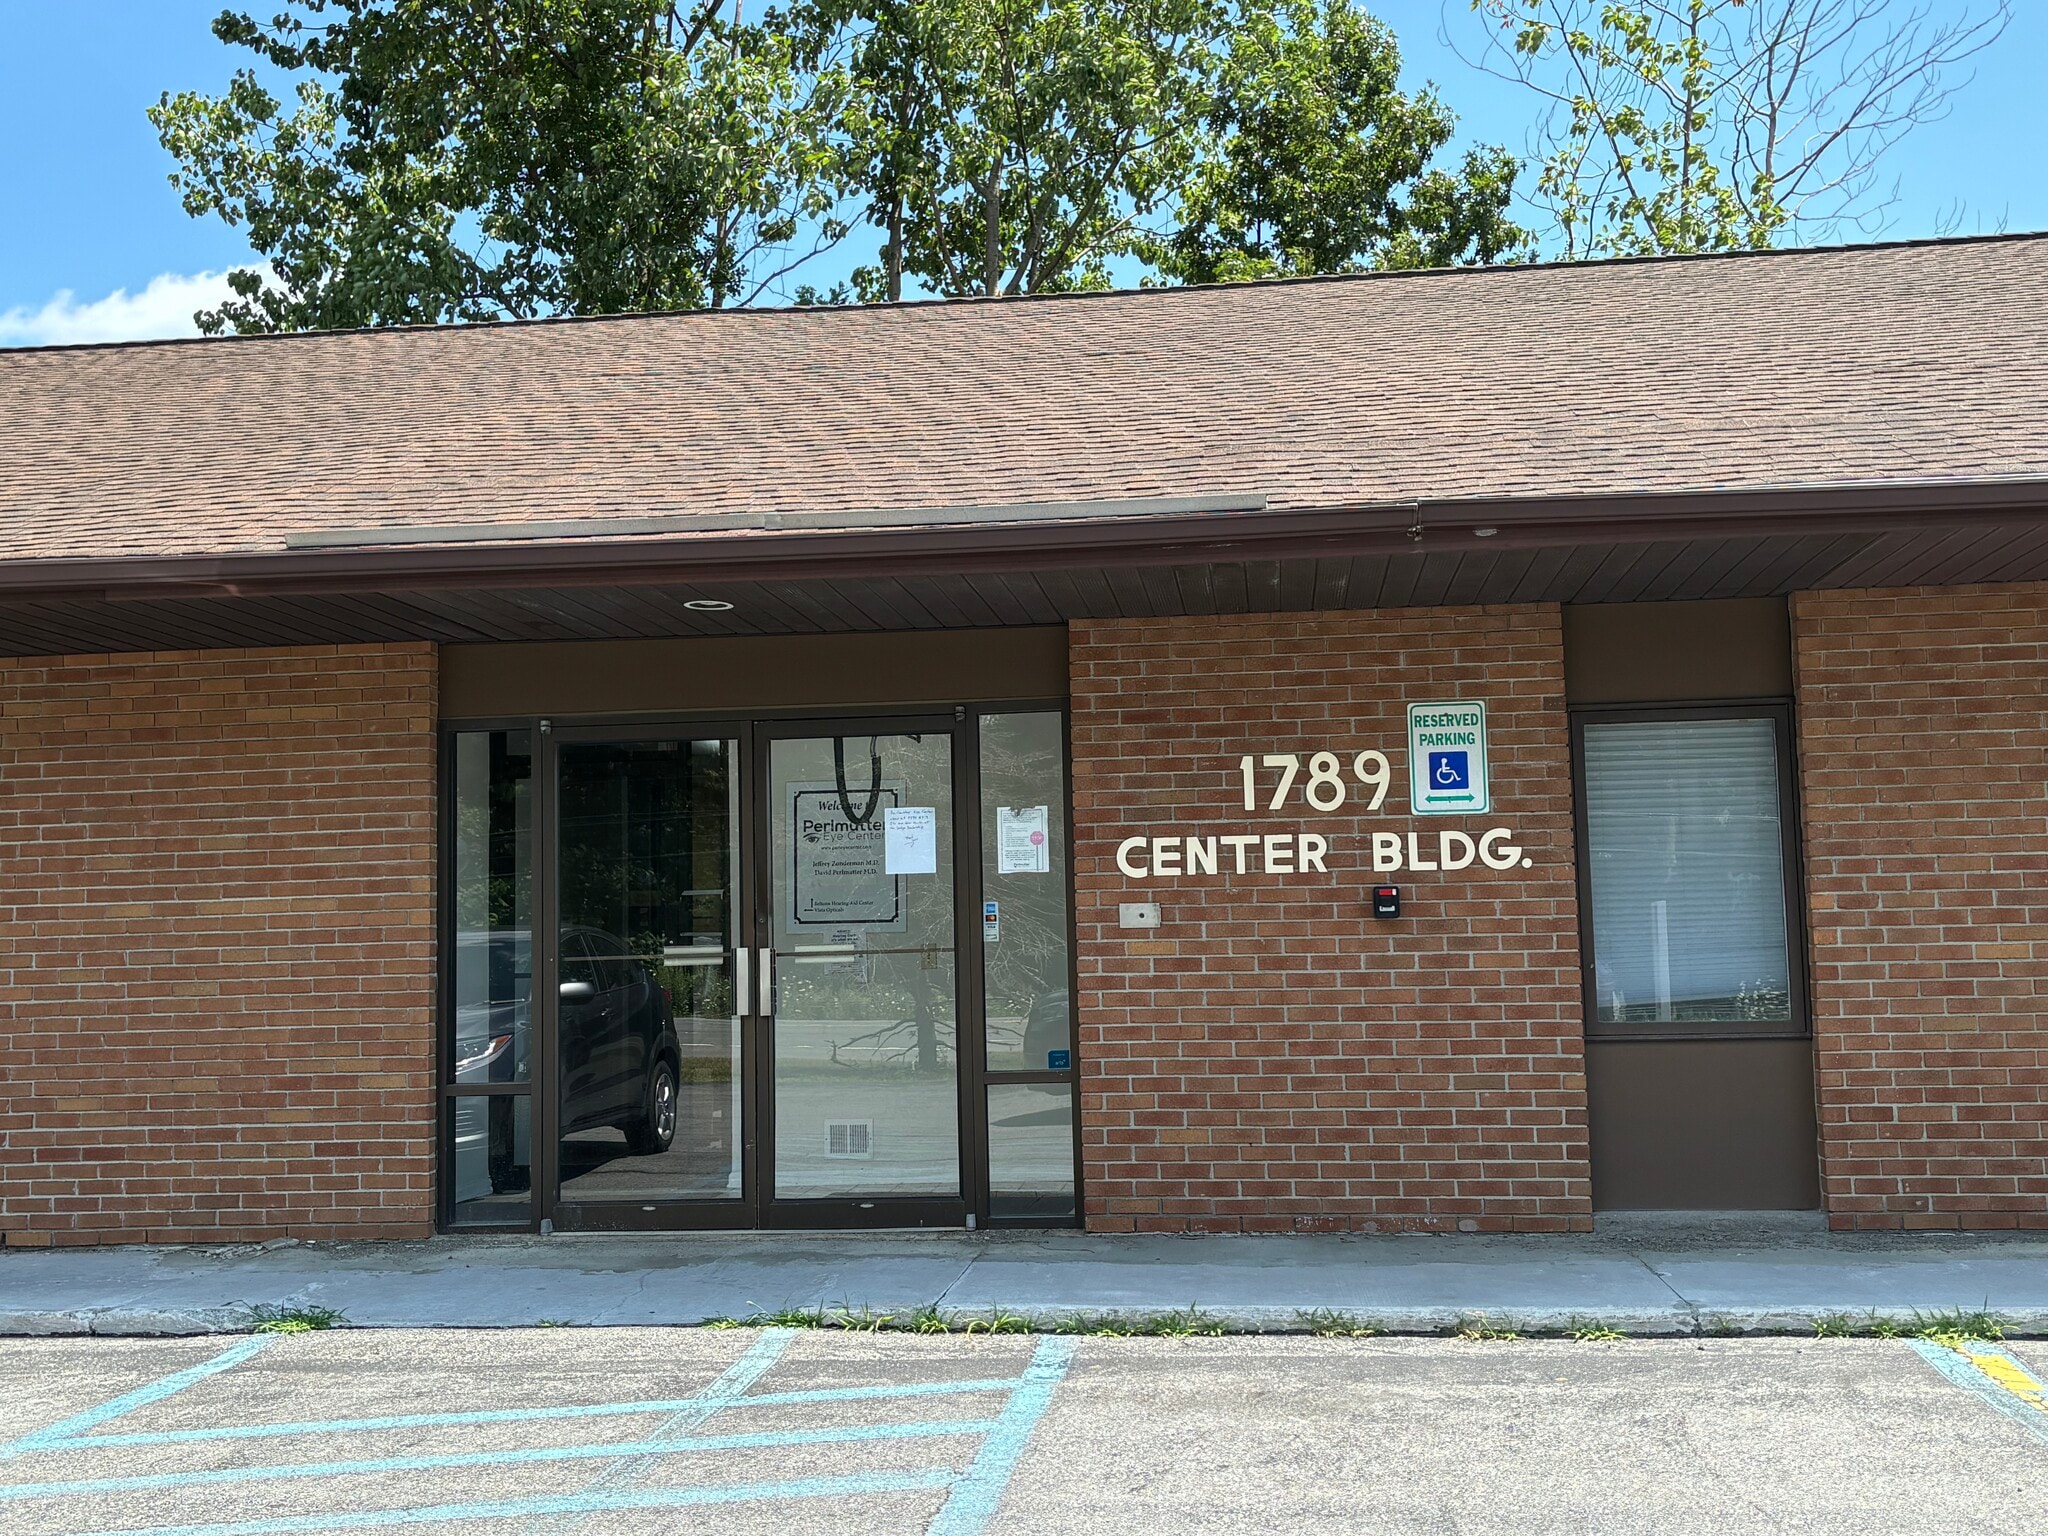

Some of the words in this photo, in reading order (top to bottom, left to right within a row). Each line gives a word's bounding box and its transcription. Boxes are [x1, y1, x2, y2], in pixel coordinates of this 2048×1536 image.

[1413, 711, 1480, 728] RESERVED
[1419, 730, 1477, 747] PARKING
[1239, 749, 1392, 812] 1789
[823, 832, 844, 842] Eye
[1116, 833, 1329, 878] CENTER
[1371, 827, 1534, 873] BLDG.
